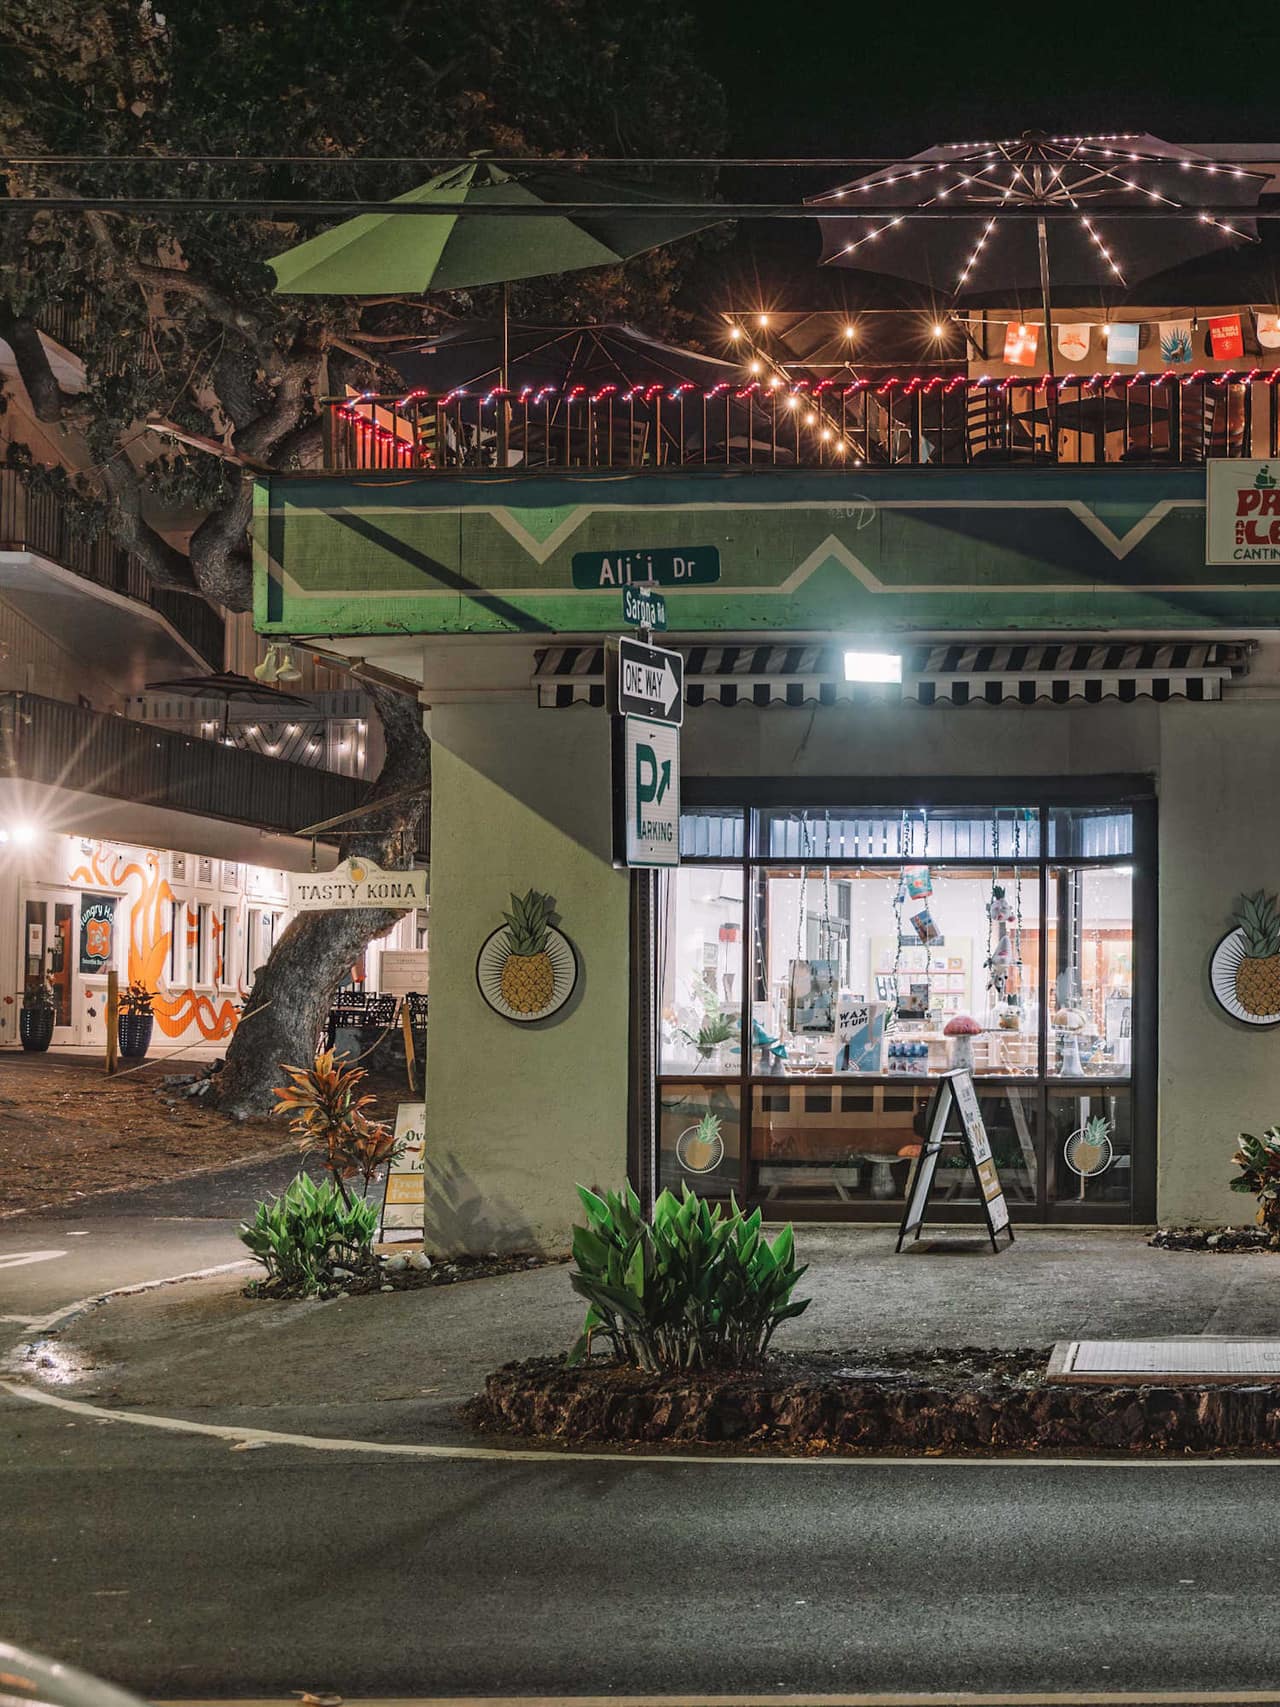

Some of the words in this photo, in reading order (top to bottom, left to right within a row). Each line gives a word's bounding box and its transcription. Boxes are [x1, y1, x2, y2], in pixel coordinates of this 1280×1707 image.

[673, 558, 696, 578] Dr
[657, 602, 665, 623] Rd
[626, 664, 643, 695] ONE
[645, 669, 664, 701] WAY
[636, 743, 673, 843] PARKING
[298, 885, 359, 899] TASTY
[368, 883, 416, 898] KONA
[840, 1008, 867, 1021] WAX
[840, 1020, 849, 1028] IT
[851, 1017, 868, 1027] UP!
